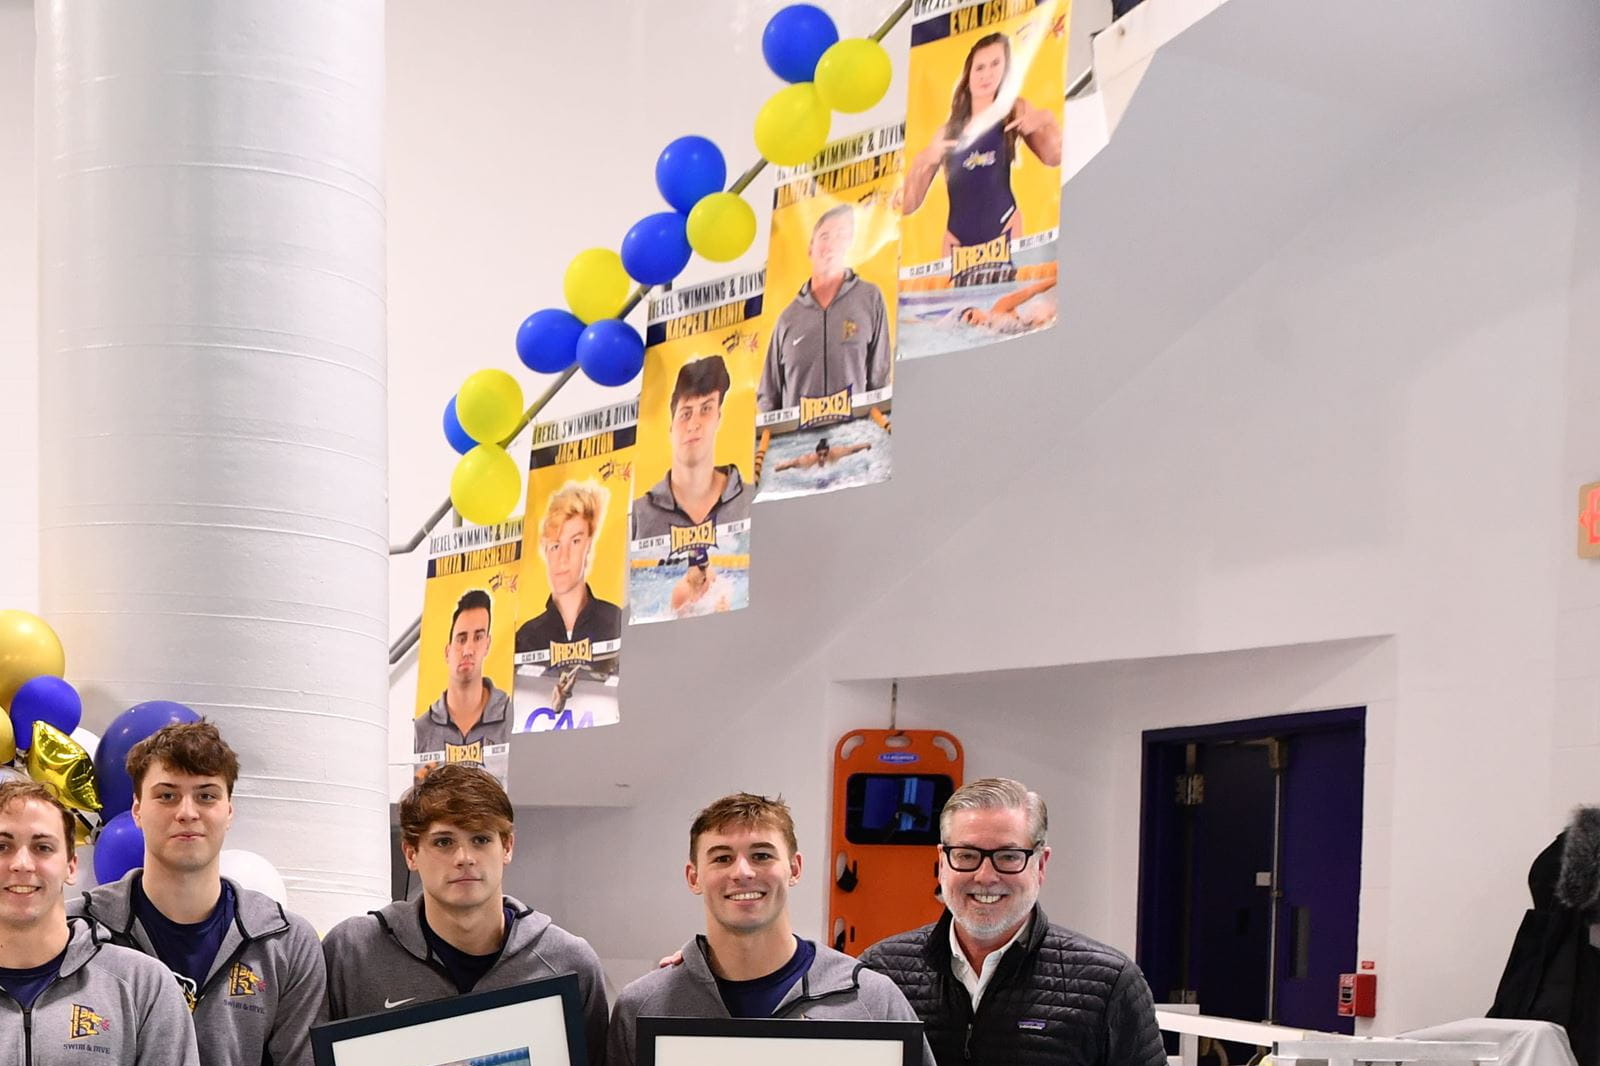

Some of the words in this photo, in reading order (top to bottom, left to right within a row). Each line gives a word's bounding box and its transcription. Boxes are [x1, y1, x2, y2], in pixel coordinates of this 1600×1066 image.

[879, 121, 906, 150] DIVIN
[678, 280, 726, 312] SWIMMING
[740, 270, 764, 295] DIVIN
[562, 411, 603, 438] SWIMMING
[614, 403, 636, 426] DIVIN
[555, 440, 579, 464] JACK
[454, 524, 493, 549] SWIMMING
[504, 518, 523, 539] DIVIN
